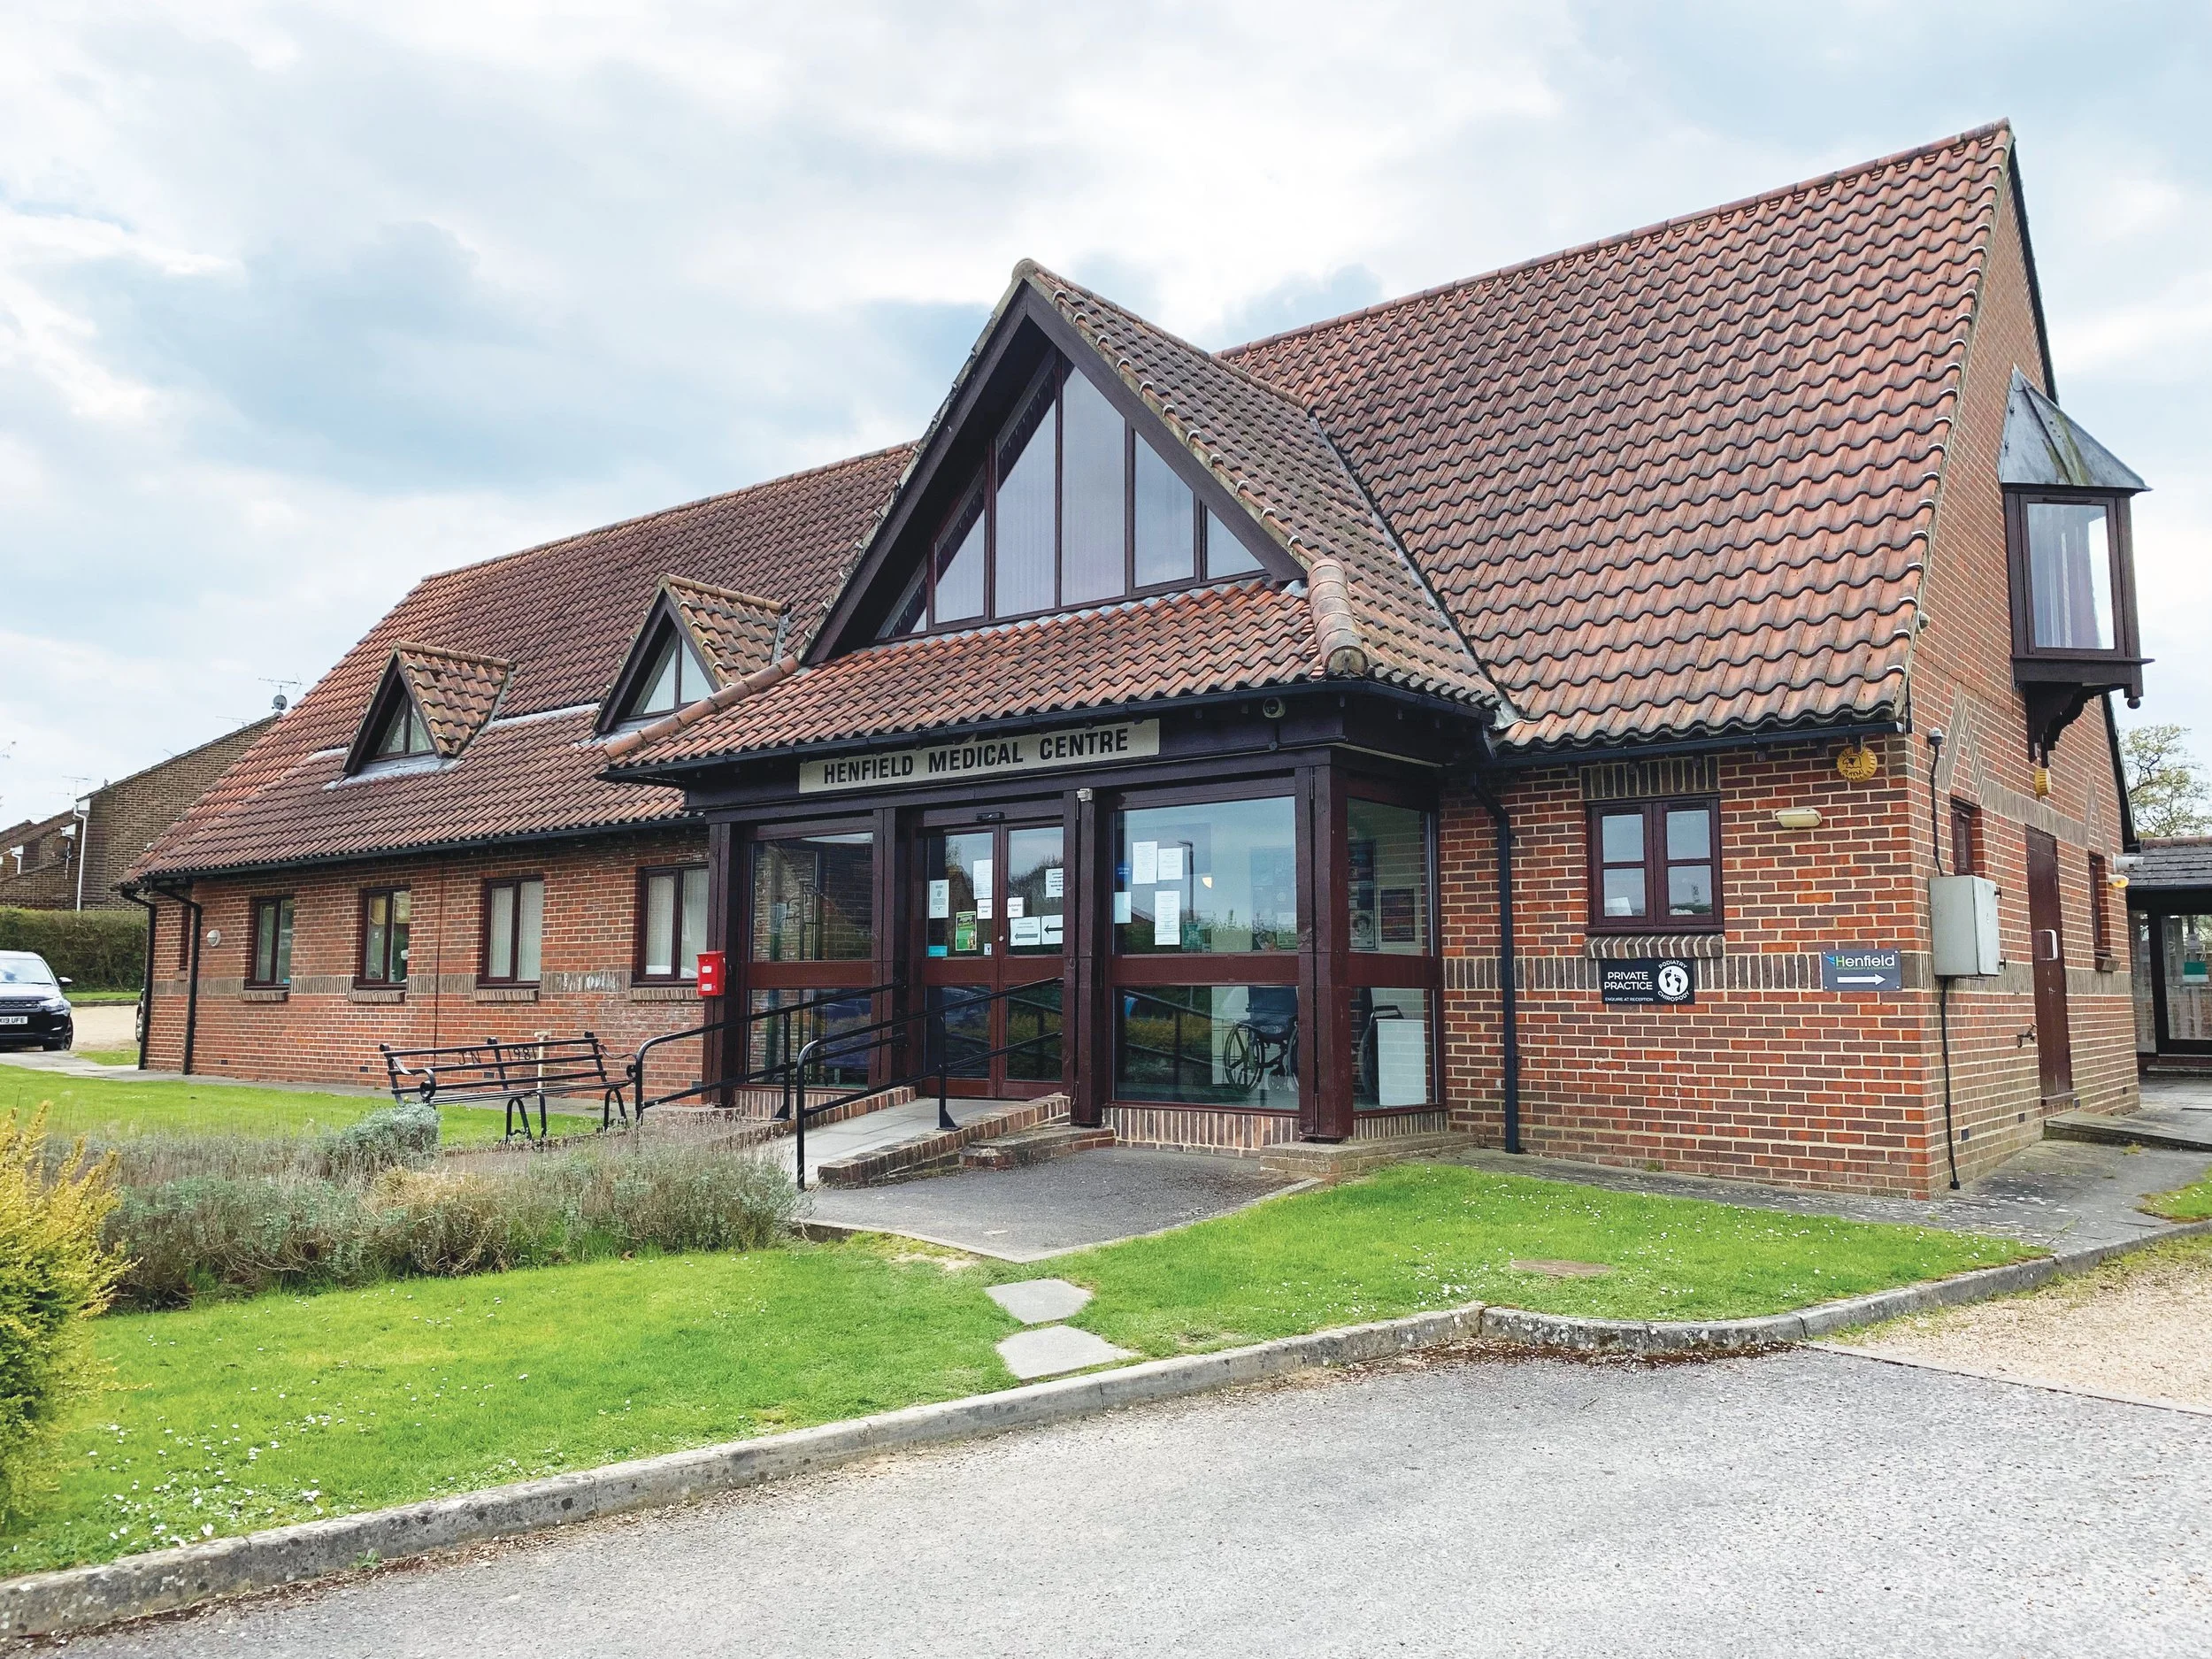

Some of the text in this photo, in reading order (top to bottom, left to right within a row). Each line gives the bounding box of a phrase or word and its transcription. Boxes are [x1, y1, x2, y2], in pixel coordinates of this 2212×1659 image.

[824, 728, 1128, 784] HENFIELD MEDICAL CENTRE
[1658, 960, 1688, 970] PODIATRY
[1836, 955, 1895, 967] Henfield
[1608, 972, 1648, 980] PRIVATE
[1604, 981, 1653, 990] PRACTICE
[1657, 990, 1690, 1002] CHIROPODY
